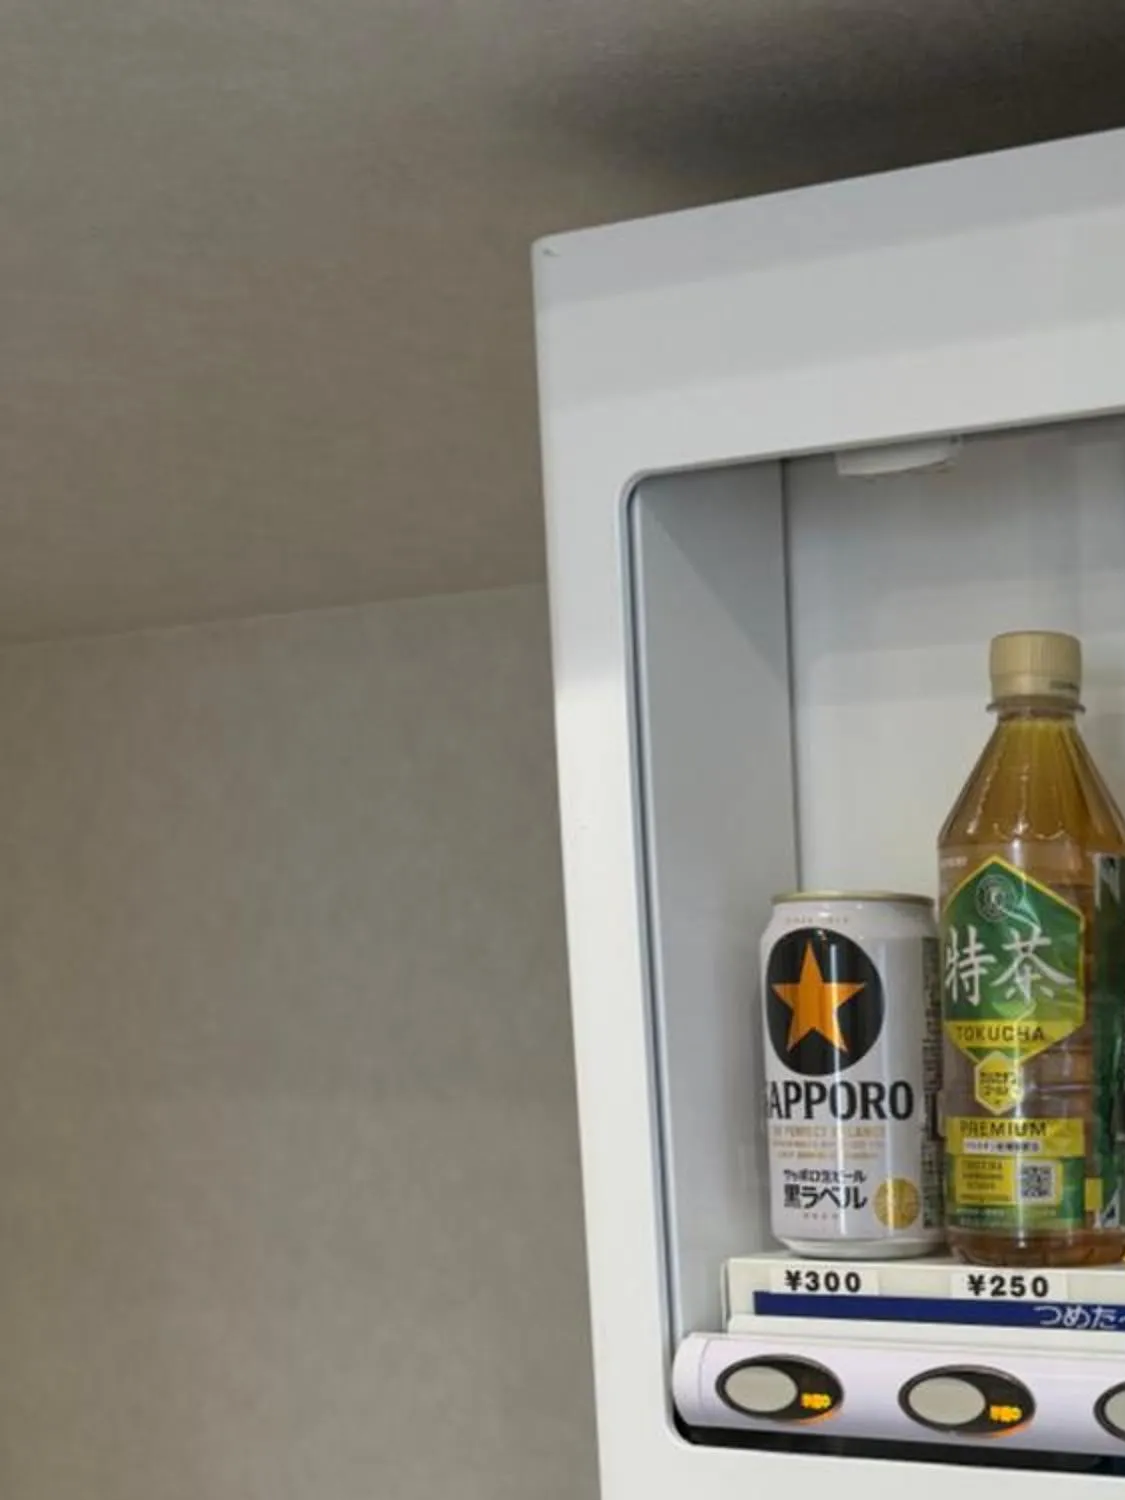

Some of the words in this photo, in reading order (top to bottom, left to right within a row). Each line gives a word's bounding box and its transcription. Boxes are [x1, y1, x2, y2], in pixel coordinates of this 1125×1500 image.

[944, 924, 1077, 1006] 特茶
[955, 1025, 1046, 1043] TOKUCHA
[768, 1080, 915, 1122] APPORO
[959, 1120, 1048, 1138] PREMIUM
[784, 1184, 868, 1210] 黒ラベル
[785, 1269, 862, 1293] ¥300
[967, 1273, 1050, 1298] ¥250
